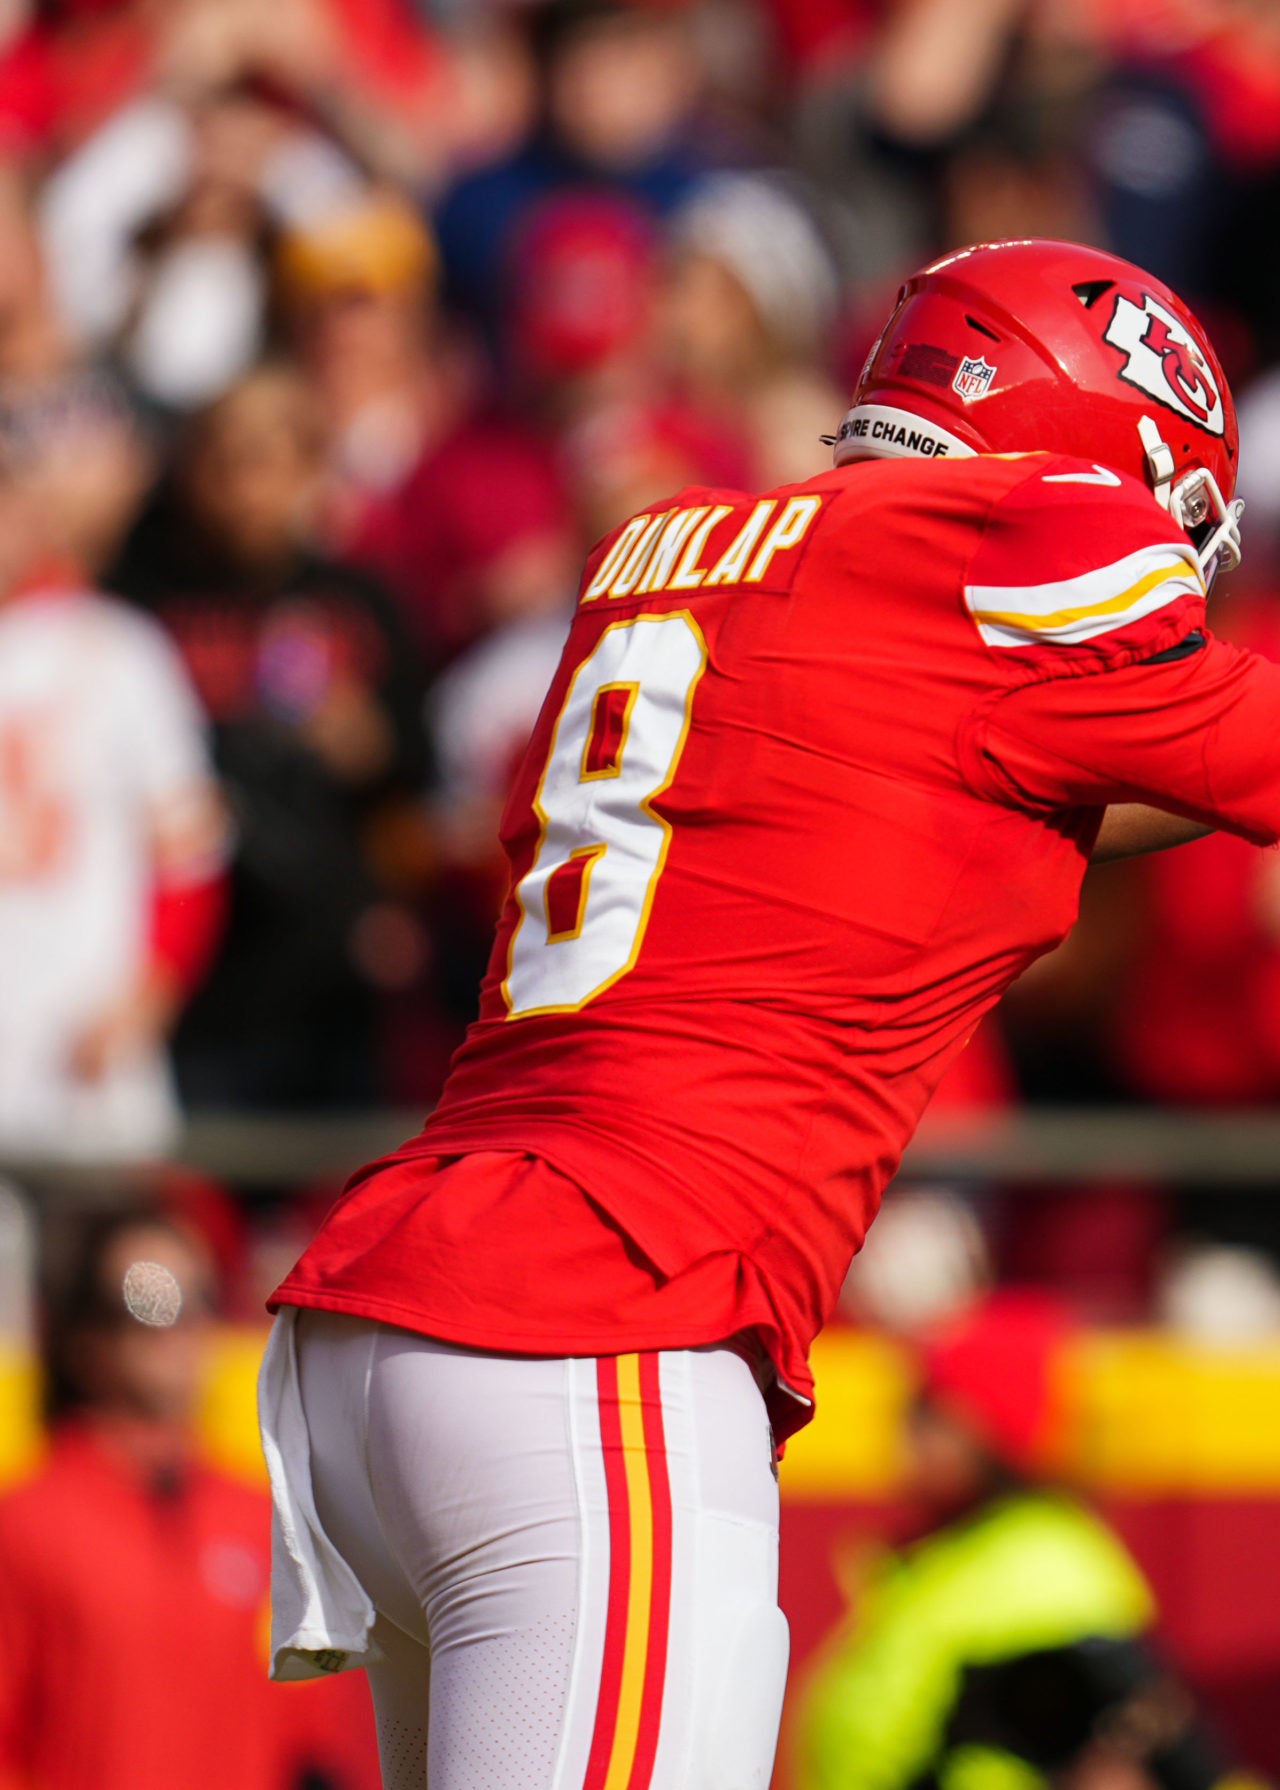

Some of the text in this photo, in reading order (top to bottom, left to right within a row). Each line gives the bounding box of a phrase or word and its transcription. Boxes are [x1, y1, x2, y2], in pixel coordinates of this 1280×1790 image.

[957, 372, 985, 394] NFL
[871, 421, 949, 458] CHANGE
[580, 495, 822, 604] DUNLAP
[500, 609, 709, 1022] 8
